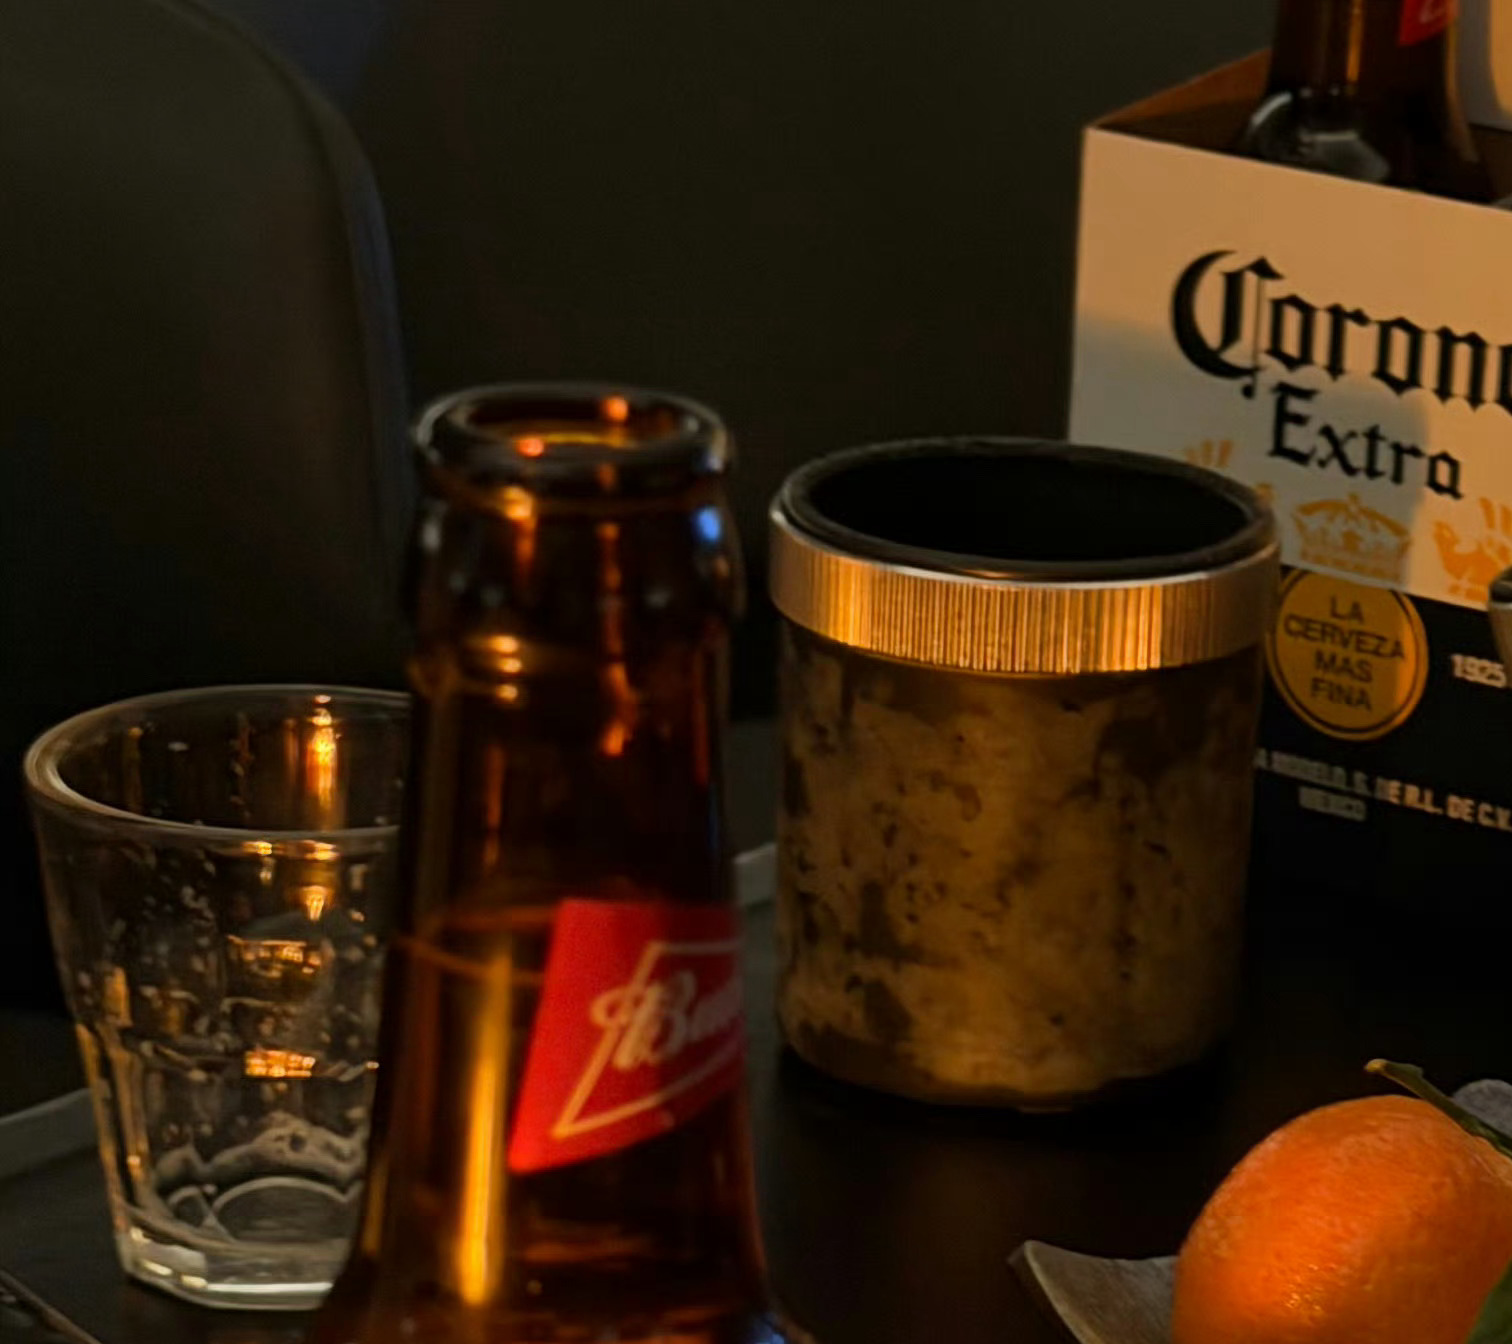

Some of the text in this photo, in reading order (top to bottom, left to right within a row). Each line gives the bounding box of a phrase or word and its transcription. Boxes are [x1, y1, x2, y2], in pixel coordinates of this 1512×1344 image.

[1268, 381, 1464, 500] Extra
[1330, 595, 1365, 623] LA
[1283, 613, 1405, 661] CERVEZA
[1309, 676, 1372, 712] FINA
